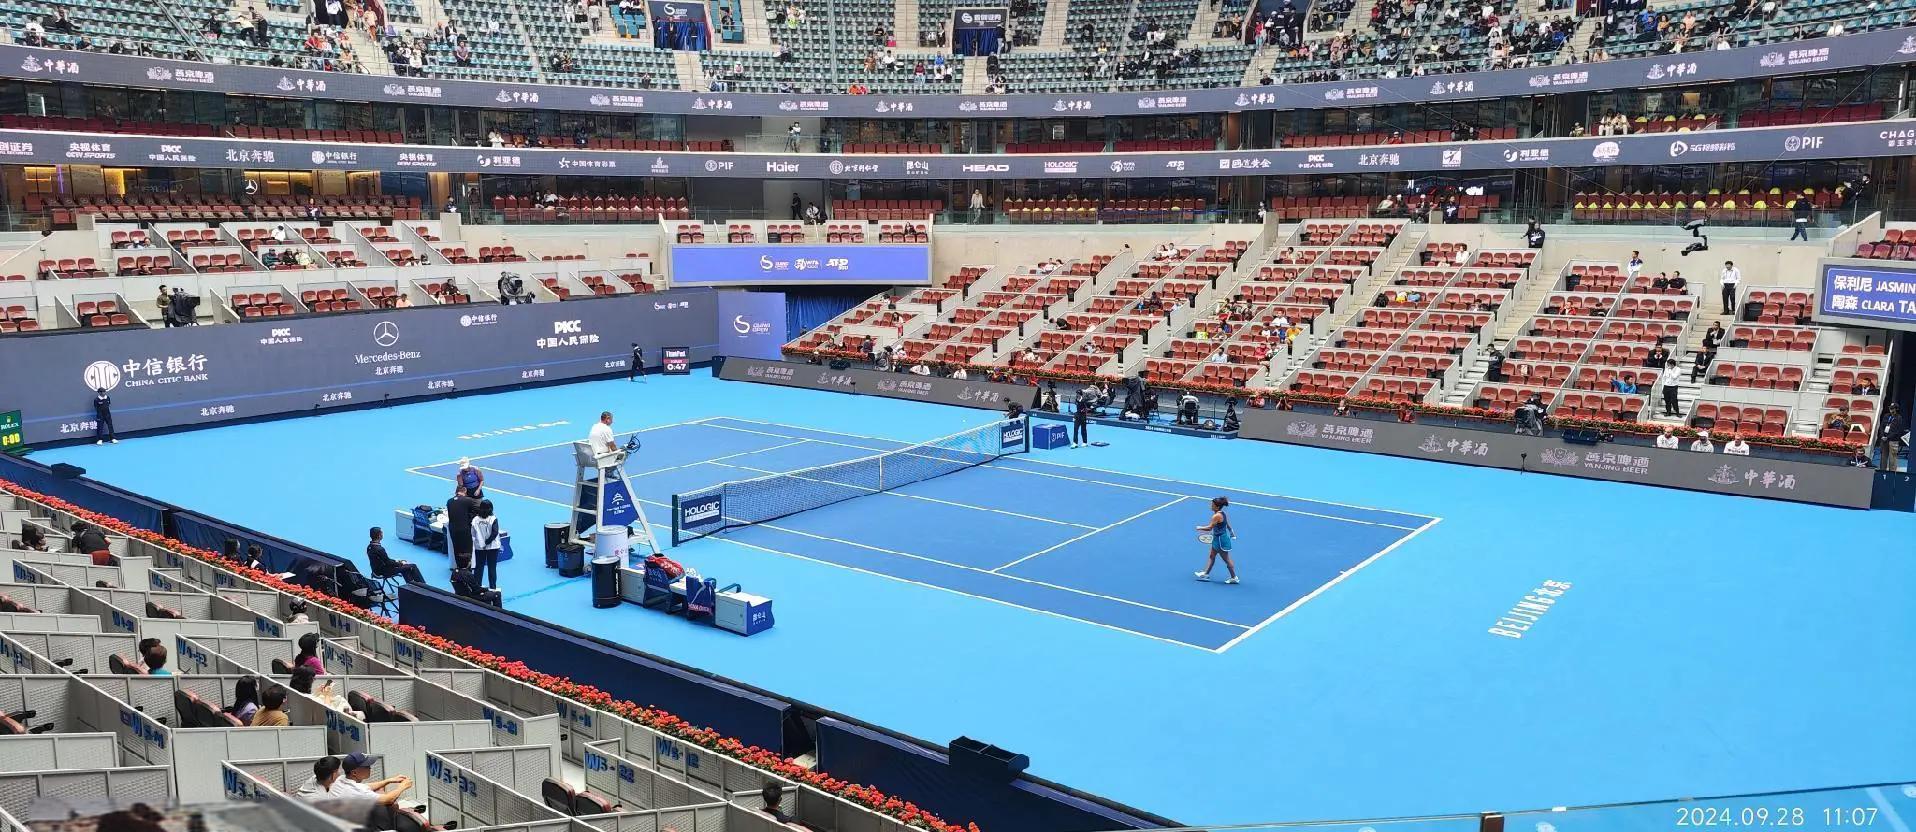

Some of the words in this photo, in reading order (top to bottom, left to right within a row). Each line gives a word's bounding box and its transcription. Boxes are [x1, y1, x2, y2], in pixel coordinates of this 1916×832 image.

[70, 142, 111, 152] 央视体育
[1802, 136, 1824, 149] PIF
[225, 148, 275, 162] 北京奔驰
[326, 151, 357, 160] 中信银行
[1358, 153, 1400, 166] 北京奔驰
[572, 160, 617, 168] 中国体育彩票
[718, 162, 734, 170] PIF
[766, 162, 800, 172] Haier
[962, 164, 1010, 172] HEAD
[1834, 274, 1873, 292] 保利尼
[1875, 281, 1916, 294] JASMIN
[1831, 294, 1859, 311] 陶森
[1861, 300, 1895, 313] CLARA
[272, 328, 291, 337] PICC
[554, 320, 582, 334] PICC
[536, 334, 600, 349] 中国人民保险
[354, 351, 422, 364] Mercedes-Benz
[122, 353, 208, 378] 中信银行
[375, 365, 404, 376] 北京奔驰
[125, 379, 155, 388] CHINA
[157, 376, 182, 384] CITIC
[183, 373, 209, 382] BANK
[200, 404, 235, 417] 北京奔驰
[0, 422, 19, 430] ROLEX
[1584, 452, 1650, 468] 燕京啤酒
[1584, 462, 1621, 472] YANJING
[1622, 465, 1648, 475] BEER
[684, 501, 720, 517] HOLOGIC
[584, 750, 635, 784] W5-22
[427, 755, 477, 797] W5-32
